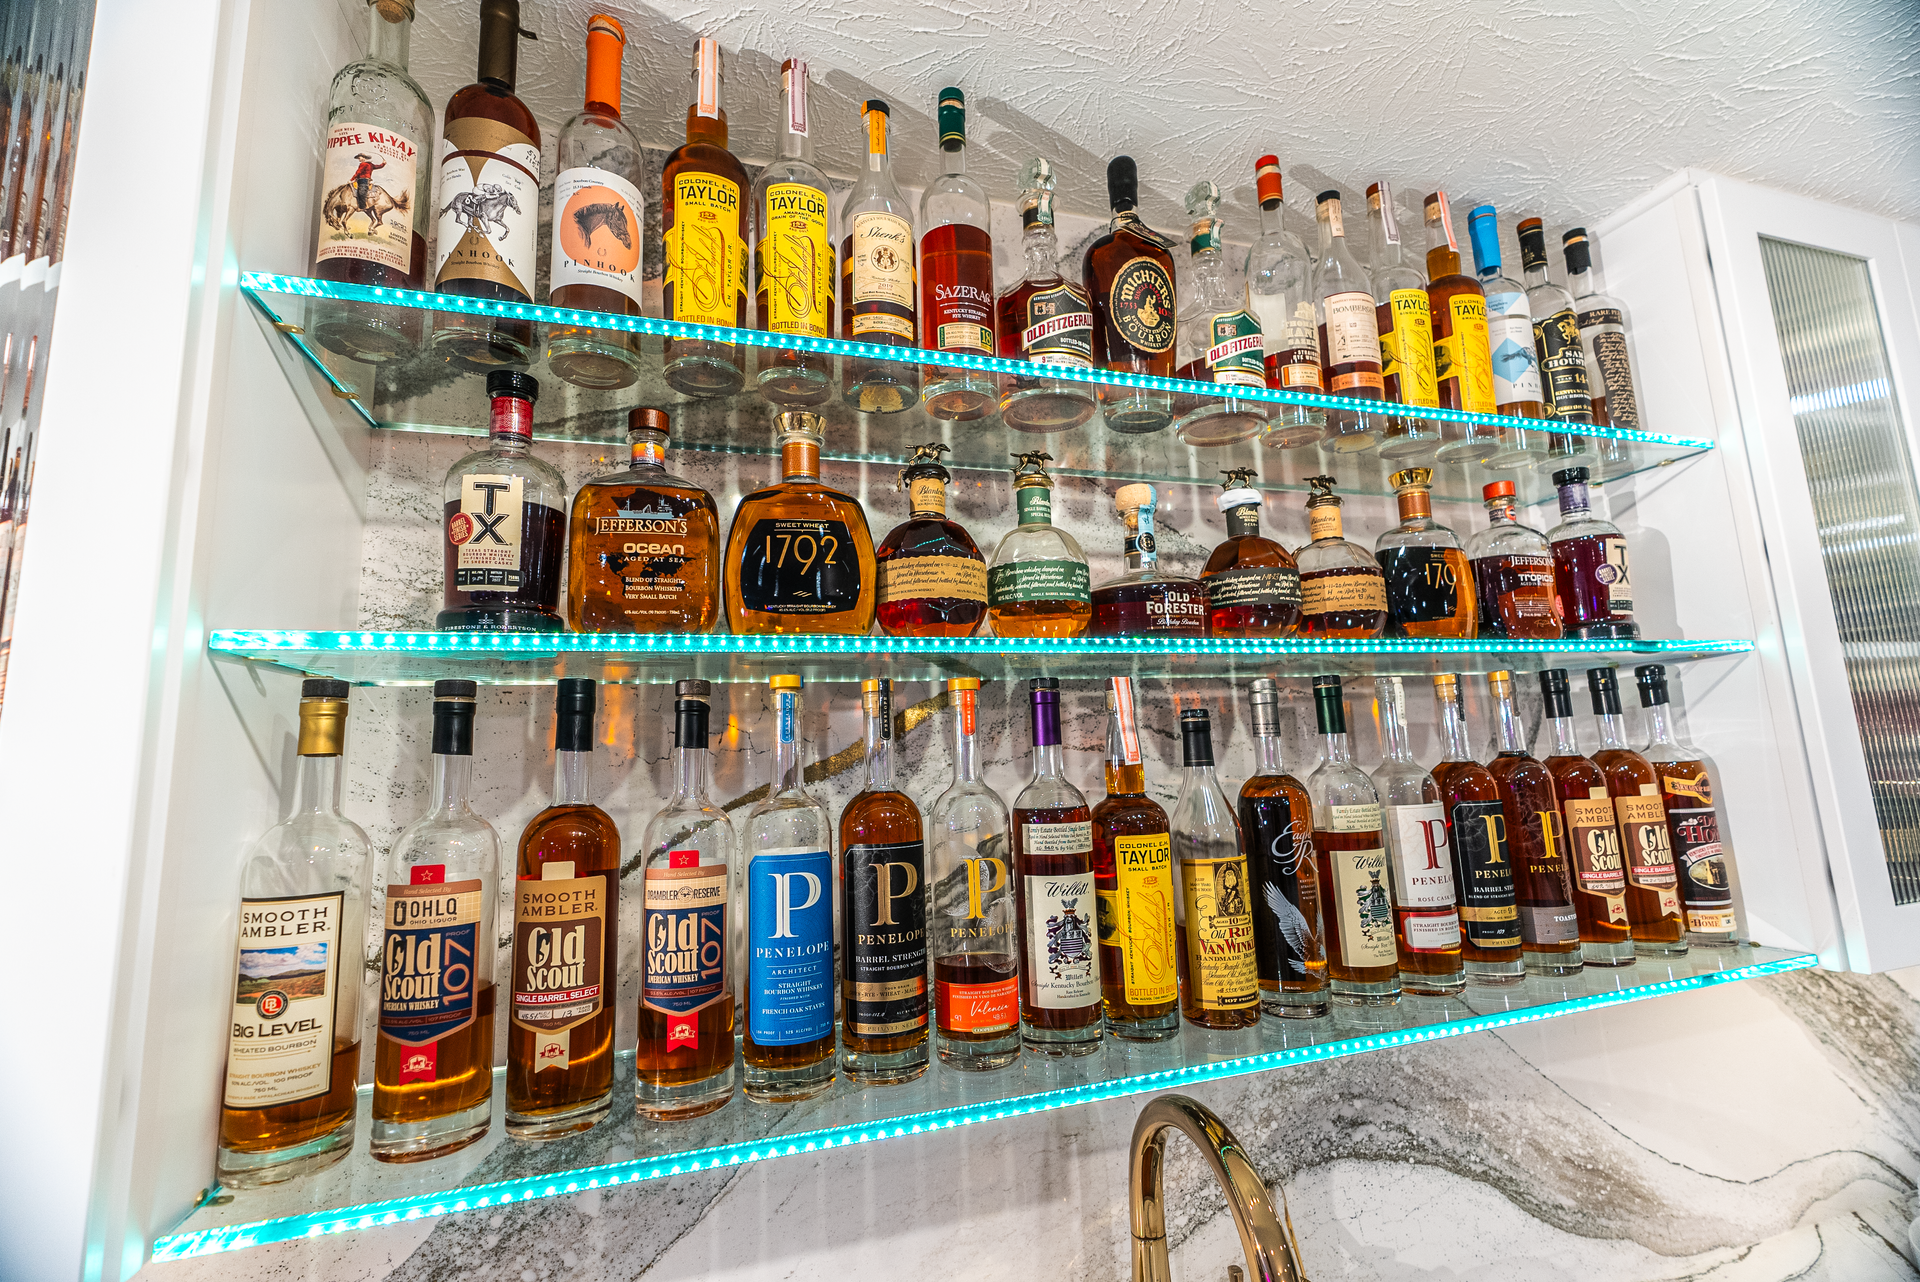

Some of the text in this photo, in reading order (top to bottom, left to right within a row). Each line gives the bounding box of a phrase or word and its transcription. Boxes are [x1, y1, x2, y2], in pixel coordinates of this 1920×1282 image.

[368, 131, 416, 157] KI-YAY
[678, 178, 737, 195] COLONEL E.H.
[679, 185, 737, 209] TAYLOR
[769, 189, 825, 204] COLONEL E.H.
[710, 203, 731, 213] BATCH
[769, 196, 825, 218] TAYLOR
[783, 210, 812, 218] AMARANTH
[811, 219, 824, 227] GODS
[860, 225, 905, 244] Shenk's
[440, 250, 515, 267] PINHOOK
[564, 259, 635, 282] PINHOOK
[609, 273, 623, 282] Whiskey
[935, 283, 992, 307] SAZERAC
[1121, 269, 1171, 309] MICHTER'S
[1134, 282, 1162, 303] SINGLE BARREL
[968, 309, 987, 318] STRAIGHT
[1120, 301, 1137, 310] 1753
[1589, 309, 1610, 317] RARE
[771, 321, 825, 336] BOTTLED IN BOND
[1026, 324, 1045, 343] OLD
[1122, 314, 1171, 342] BOURBON
[981, 329, 992, 346] 18
[1140, 339, 1161, 348] WHISKEY
[1574, 373, 1586, 384] 14
[451, 517, 467, 531] BARREL
[594, 517, 688, 535] JEFFERSON'S
[453, 531, 469, 543] SERIES
[766, 534, 838, 575] 1792
[1518, 574, 1554, 583] TROPICS
[1168, 591, 1190, 602] OLD
[1146, 601, 1205, 616] FORESTER
[491, 624, 537, 632] ROBERTSON
[1415, 818, 1448, 871] P
[1587, 828, 1619, 856] Old
[1638, 824, 1671, 851] Old
[1119, 847, 1170, 865] TAYLOR
[522, 888, 596, 904] SMOOTH
[868, 861, 918, 927] P
[961, 857, 1007, 920] P
[1473, 885, 1504, 893] BARREL
[410, 897, 458, 918] OHLQ
[701, 909, 720, 917] PROOF
[767, 871, 822, 939] P
[243, 906, 328, 924] SMOOTH
[1691, 917, 1720, 928] HOME
[445, 929, 470, 937] PROOF
[647, 912, 699, 951] Old
[857, 927, 925, 945] PENELOPE
[1210, 926, 1252, 939] Old RIP
[527, 924, 585, 967] Old
[700, 917, 721, 981] 107
[756, 940, 829, 959] PENELOPE
[386, 933, 442, 976] Old
[647, 948, 699, 975] Scout
[1195, 953, 1242, 962] HANDMADE
[442, 938, 471, 1007] 107
[526, 962, 585, 992] Scout
[647, 973, 699, 985] AMERICAN WHISKEY
[771, 965, 817, 976] ARCHITECT
[383, 972, 442, 1001] Scout
[764, 982, 824, 995] BOURBON WHISKEY
[778, 979, 812, 989] STRAIGHT
[1129, 986, 1158, 997] BOTTLED
[1158, 985, 1165, 995] IN
[515, 986, 598, 1002] SINGLE BARREL SELECT
[383, 999, 440, 1011] AMERICAN WHISKEY
[789, 1006, 804, 1014] OAK
[804, 1001, 825, 1012] STAVES
[970, 1000, 1010, 1017] Valencia
[232, 1017, 323, 1038] BIG LEVEL
[267, 1038, 317, 1052] BOURBON
[251, 1070, 286, 1079] BOURBON
[287, 1062, 321, 1074] WHISKEY
